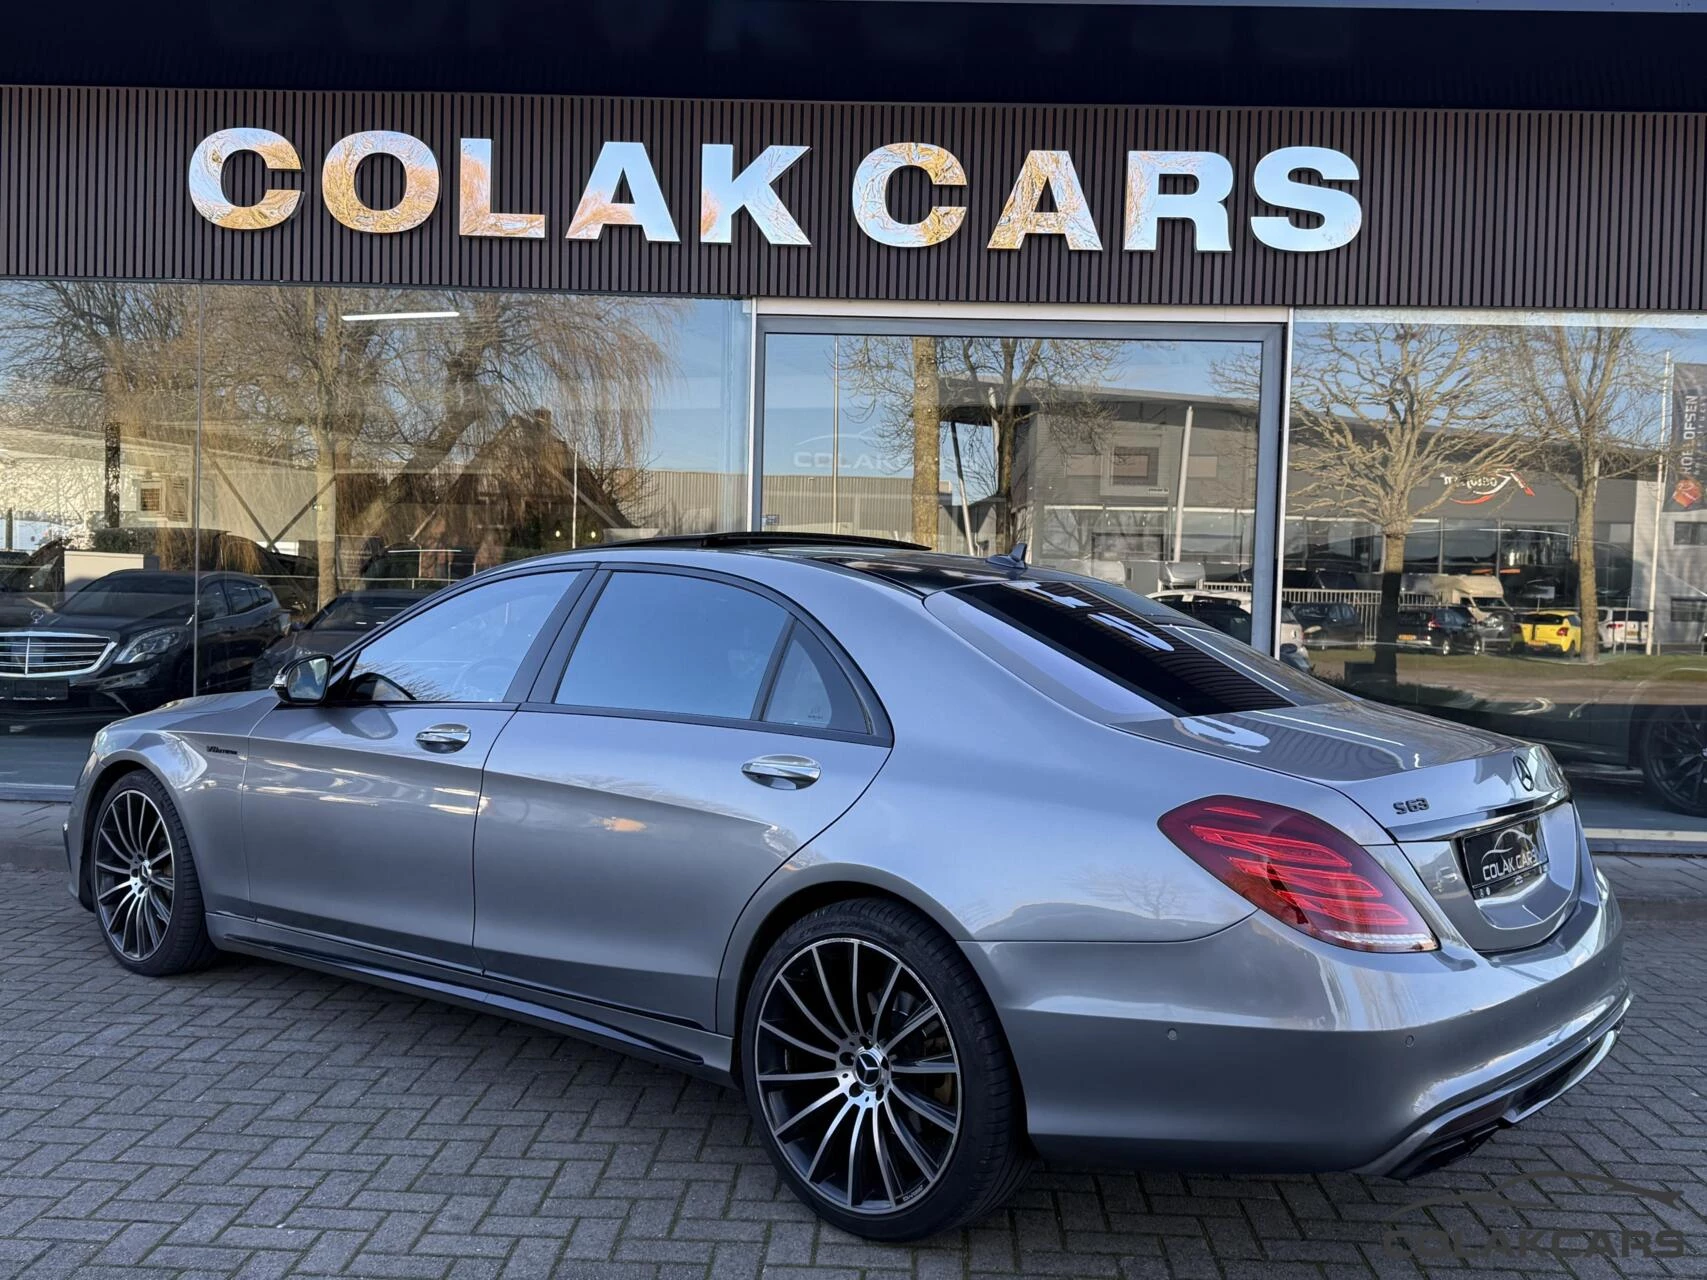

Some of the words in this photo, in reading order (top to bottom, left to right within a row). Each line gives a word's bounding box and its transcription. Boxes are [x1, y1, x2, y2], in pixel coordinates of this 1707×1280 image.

[189, 127, 813, 247] COLAK
[852, 141, 1363, 253] CARS
[1482, 857, 1515, 881] COLAK
[1515, 848, 1537, 869] CARS
